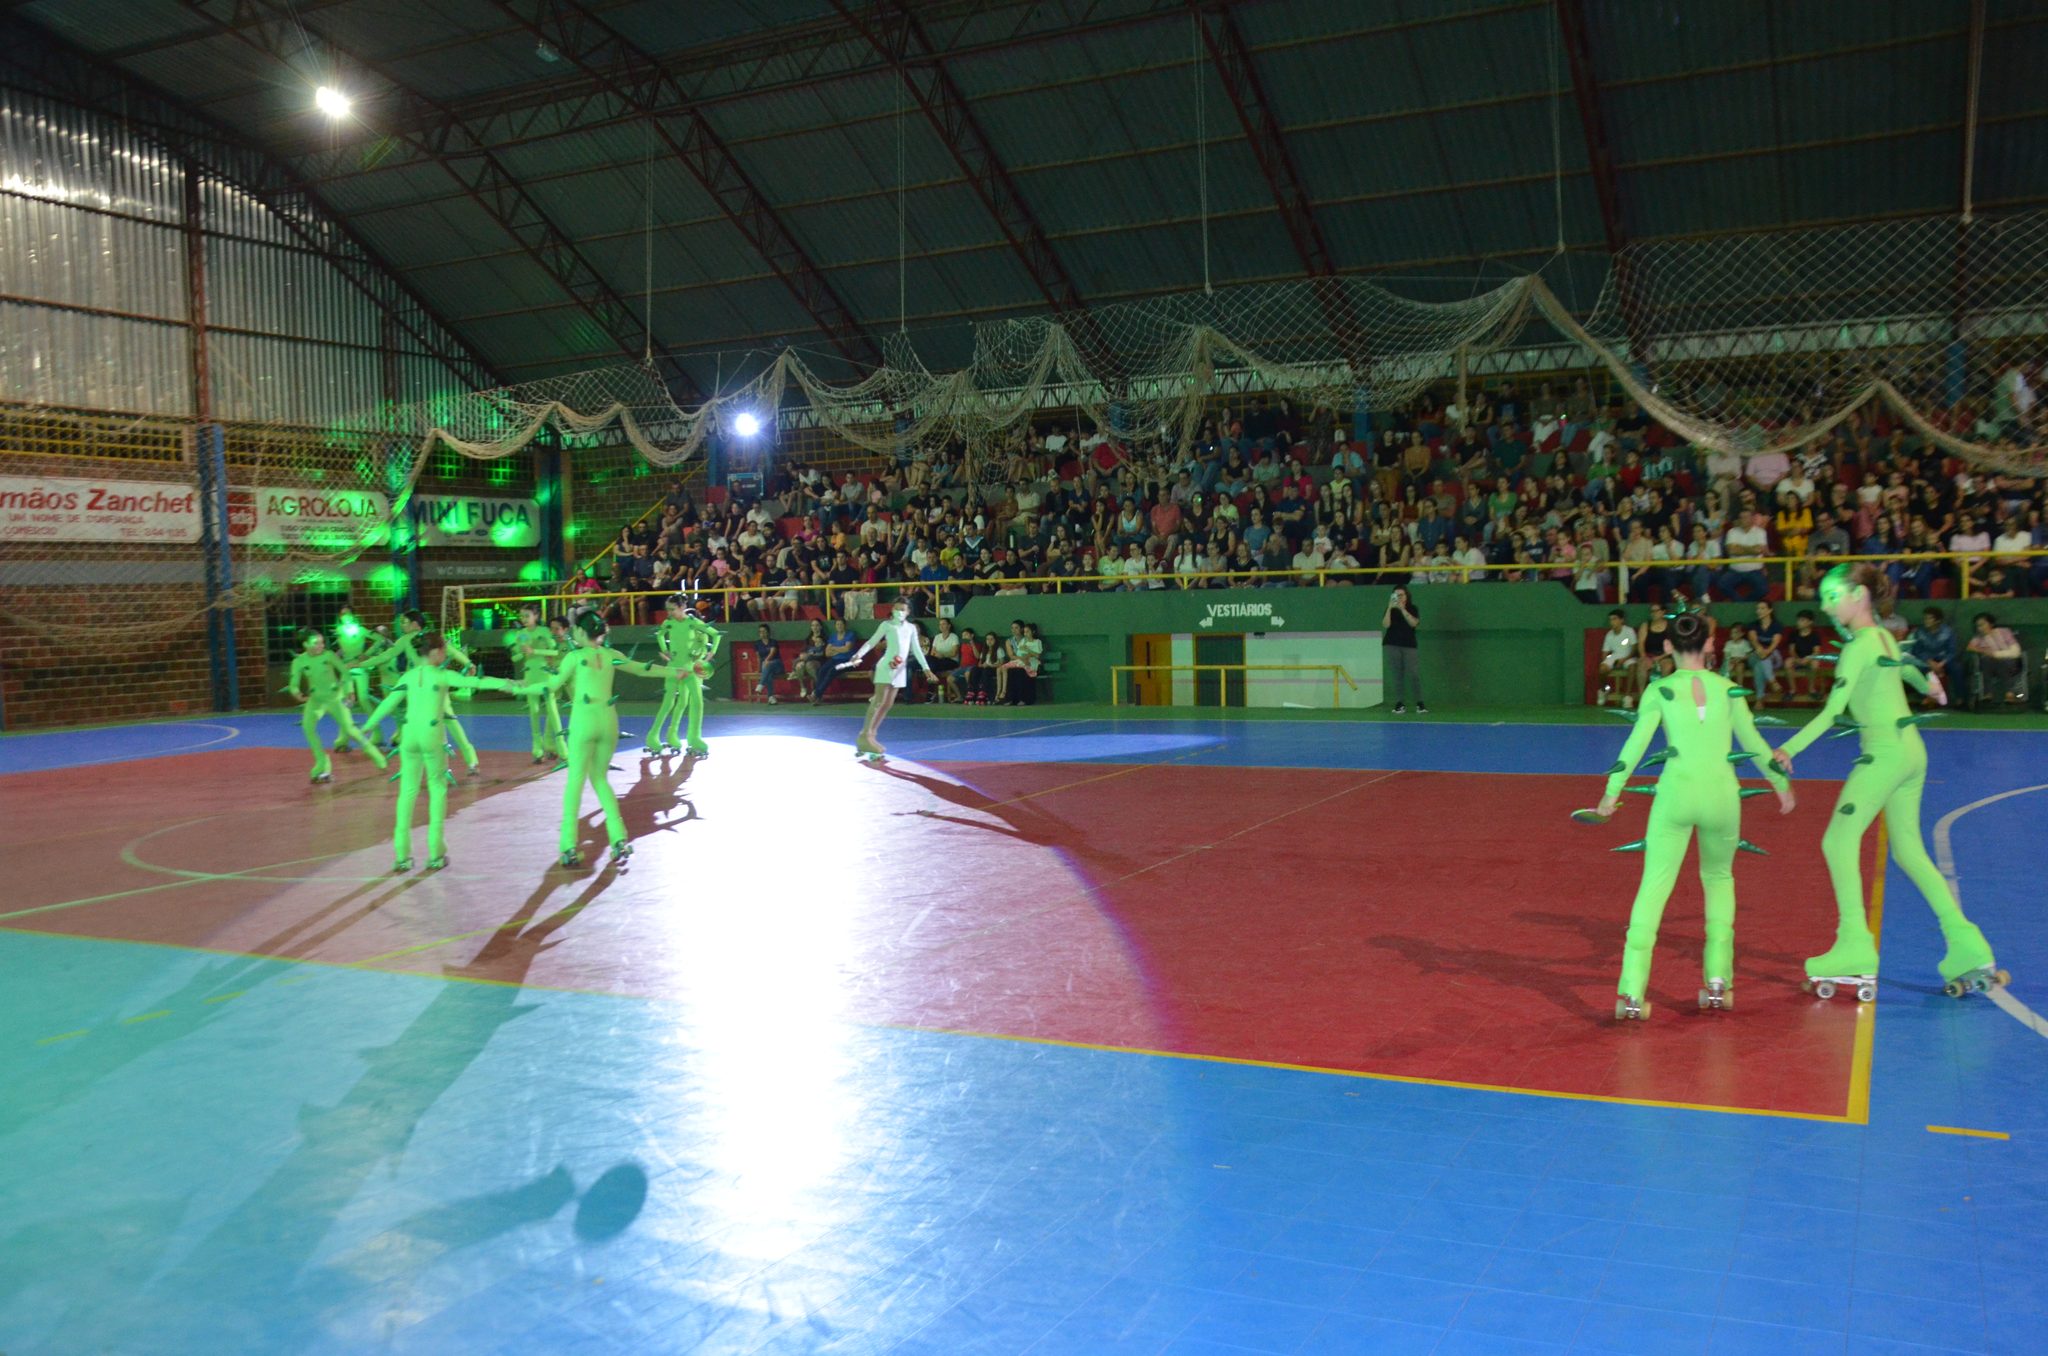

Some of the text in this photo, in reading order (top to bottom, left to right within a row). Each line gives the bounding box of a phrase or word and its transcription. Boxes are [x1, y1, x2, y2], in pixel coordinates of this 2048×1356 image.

[87, 488, 194, 514] Zanchet
[266, 495, 377, 518] AGROLOJA
[467, 502, 531, 528] FUCA
[1206, 602, 1272, 617] VESTIÁRIOS
